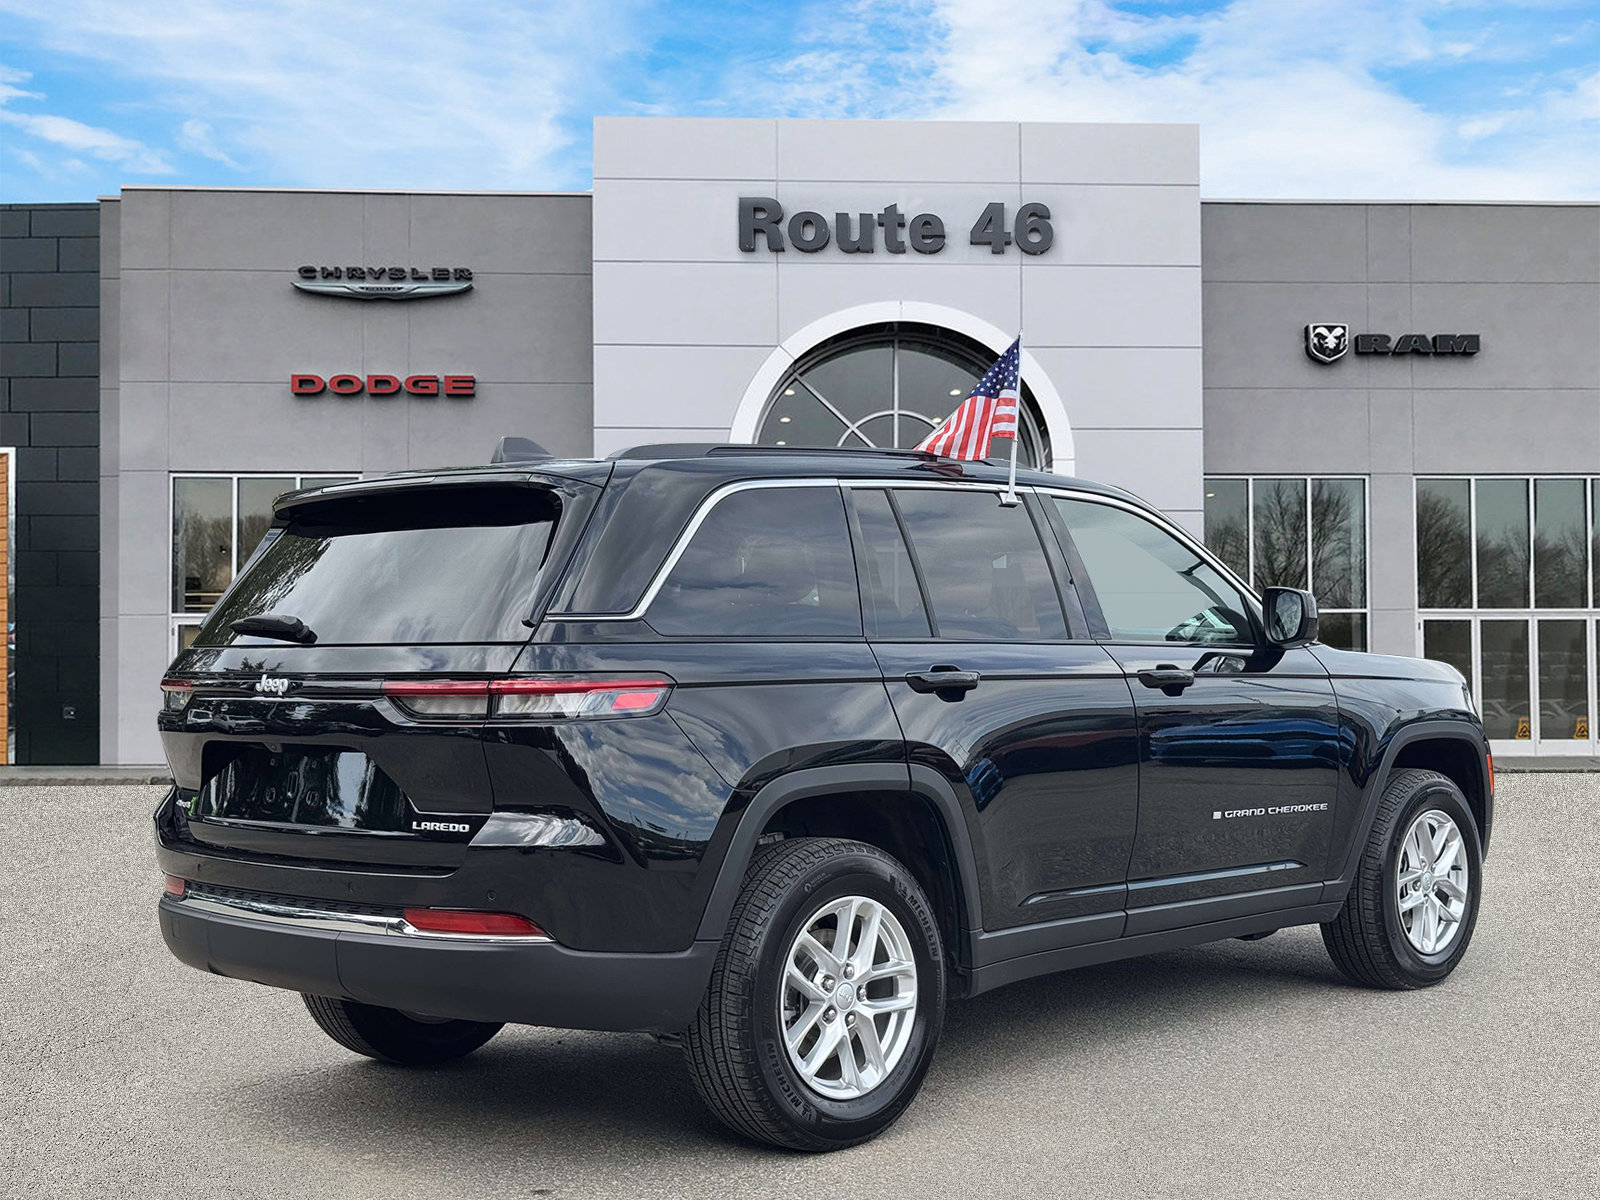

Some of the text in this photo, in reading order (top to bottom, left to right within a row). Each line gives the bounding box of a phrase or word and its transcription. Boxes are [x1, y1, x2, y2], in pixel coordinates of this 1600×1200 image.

[738, 197, 1054, 255] Route 46
[298, 265, 473, 280] CHRYSLER
[1354, 334, 1480, 355] RAM
[291, 374, 476, 396] DODGE
[255, 674, 289, 696] Jeep
[1224, 803, 1328, 818] GRAND CHEROKEE
[412, 821, 470, 833] LAREDO
[907, 894, 939, 957] MICHELIN
[766, 1042, 803, 1108] MICHELIN
